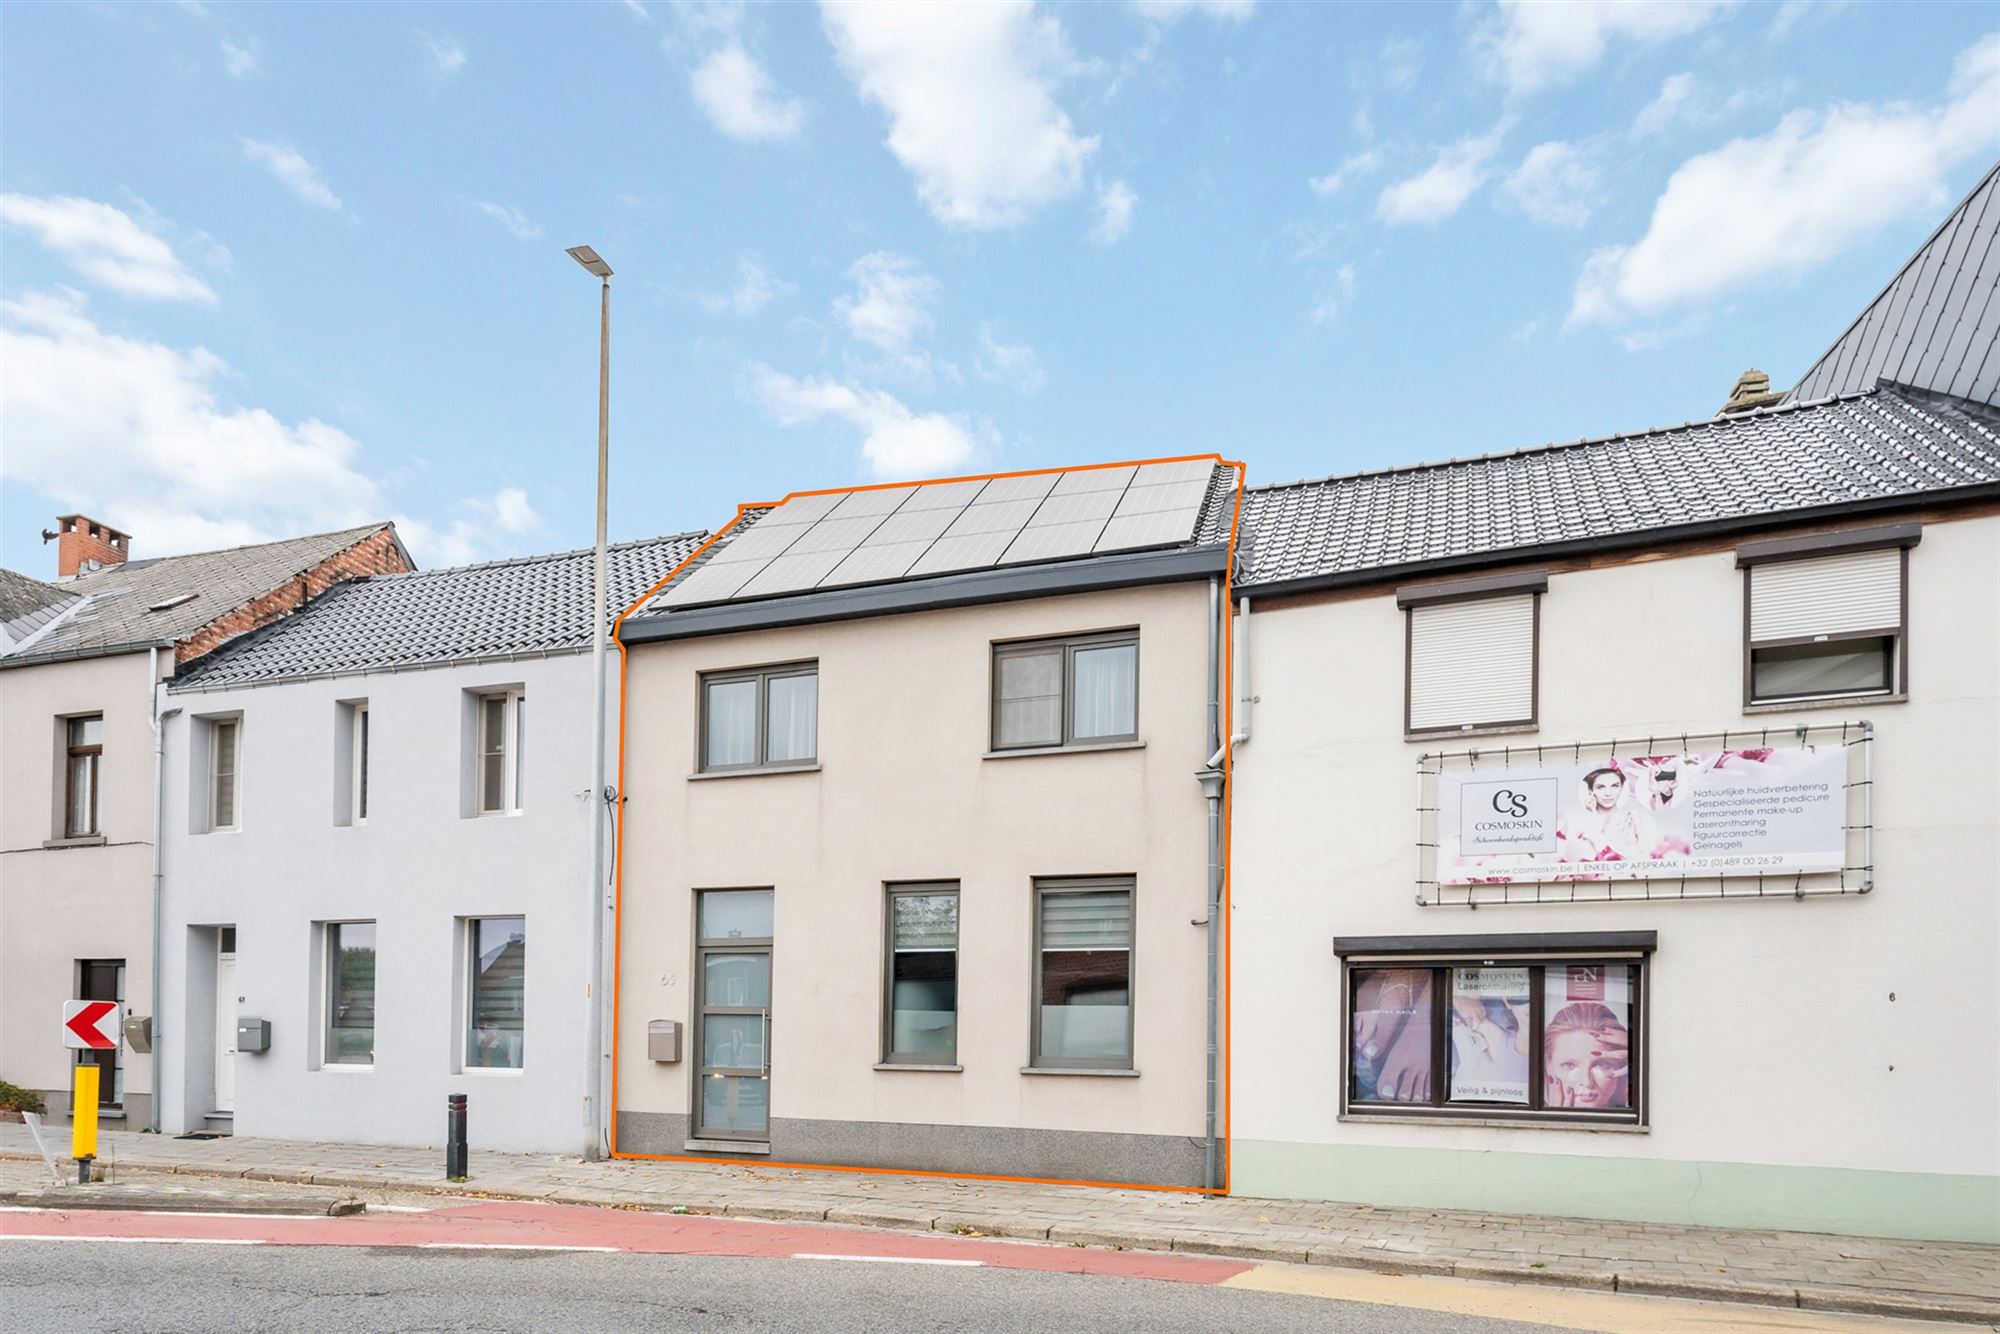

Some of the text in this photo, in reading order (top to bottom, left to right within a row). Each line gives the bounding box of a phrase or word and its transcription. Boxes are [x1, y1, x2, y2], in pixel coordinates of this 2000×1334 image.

[1693, 782, 1829, 798] Natuurlijke huidverbetering
[1492, 789, 1528, 818] CS
[1693, 793, 1830, 809] Gespecialiseerde pedicure
[1693, 805, 1804, 819] Permanente make-up
[1475, 820, 1543, 831] COSMOSKIN
[1693, 818, 1767, 830] Laserontharing
[1693, 829, 1767, 841] Figuurcorrectie
[1693, 840, 1744, 851] Gelnagels
[1488, 864, 1573, 875] www.cosmoskin.be
[1583, 863, 1611, 872] ENKEL
[1613, 861, 1628, 871] OP
[1630, 860, 1679, 870] AFSPRAAK
[1691, 859, 1707, 868] +32
[1743, 856, 1755, 866] 00
[1757, 856, 1770, 866] 26
[1772, 855, 1784, 865] 29
